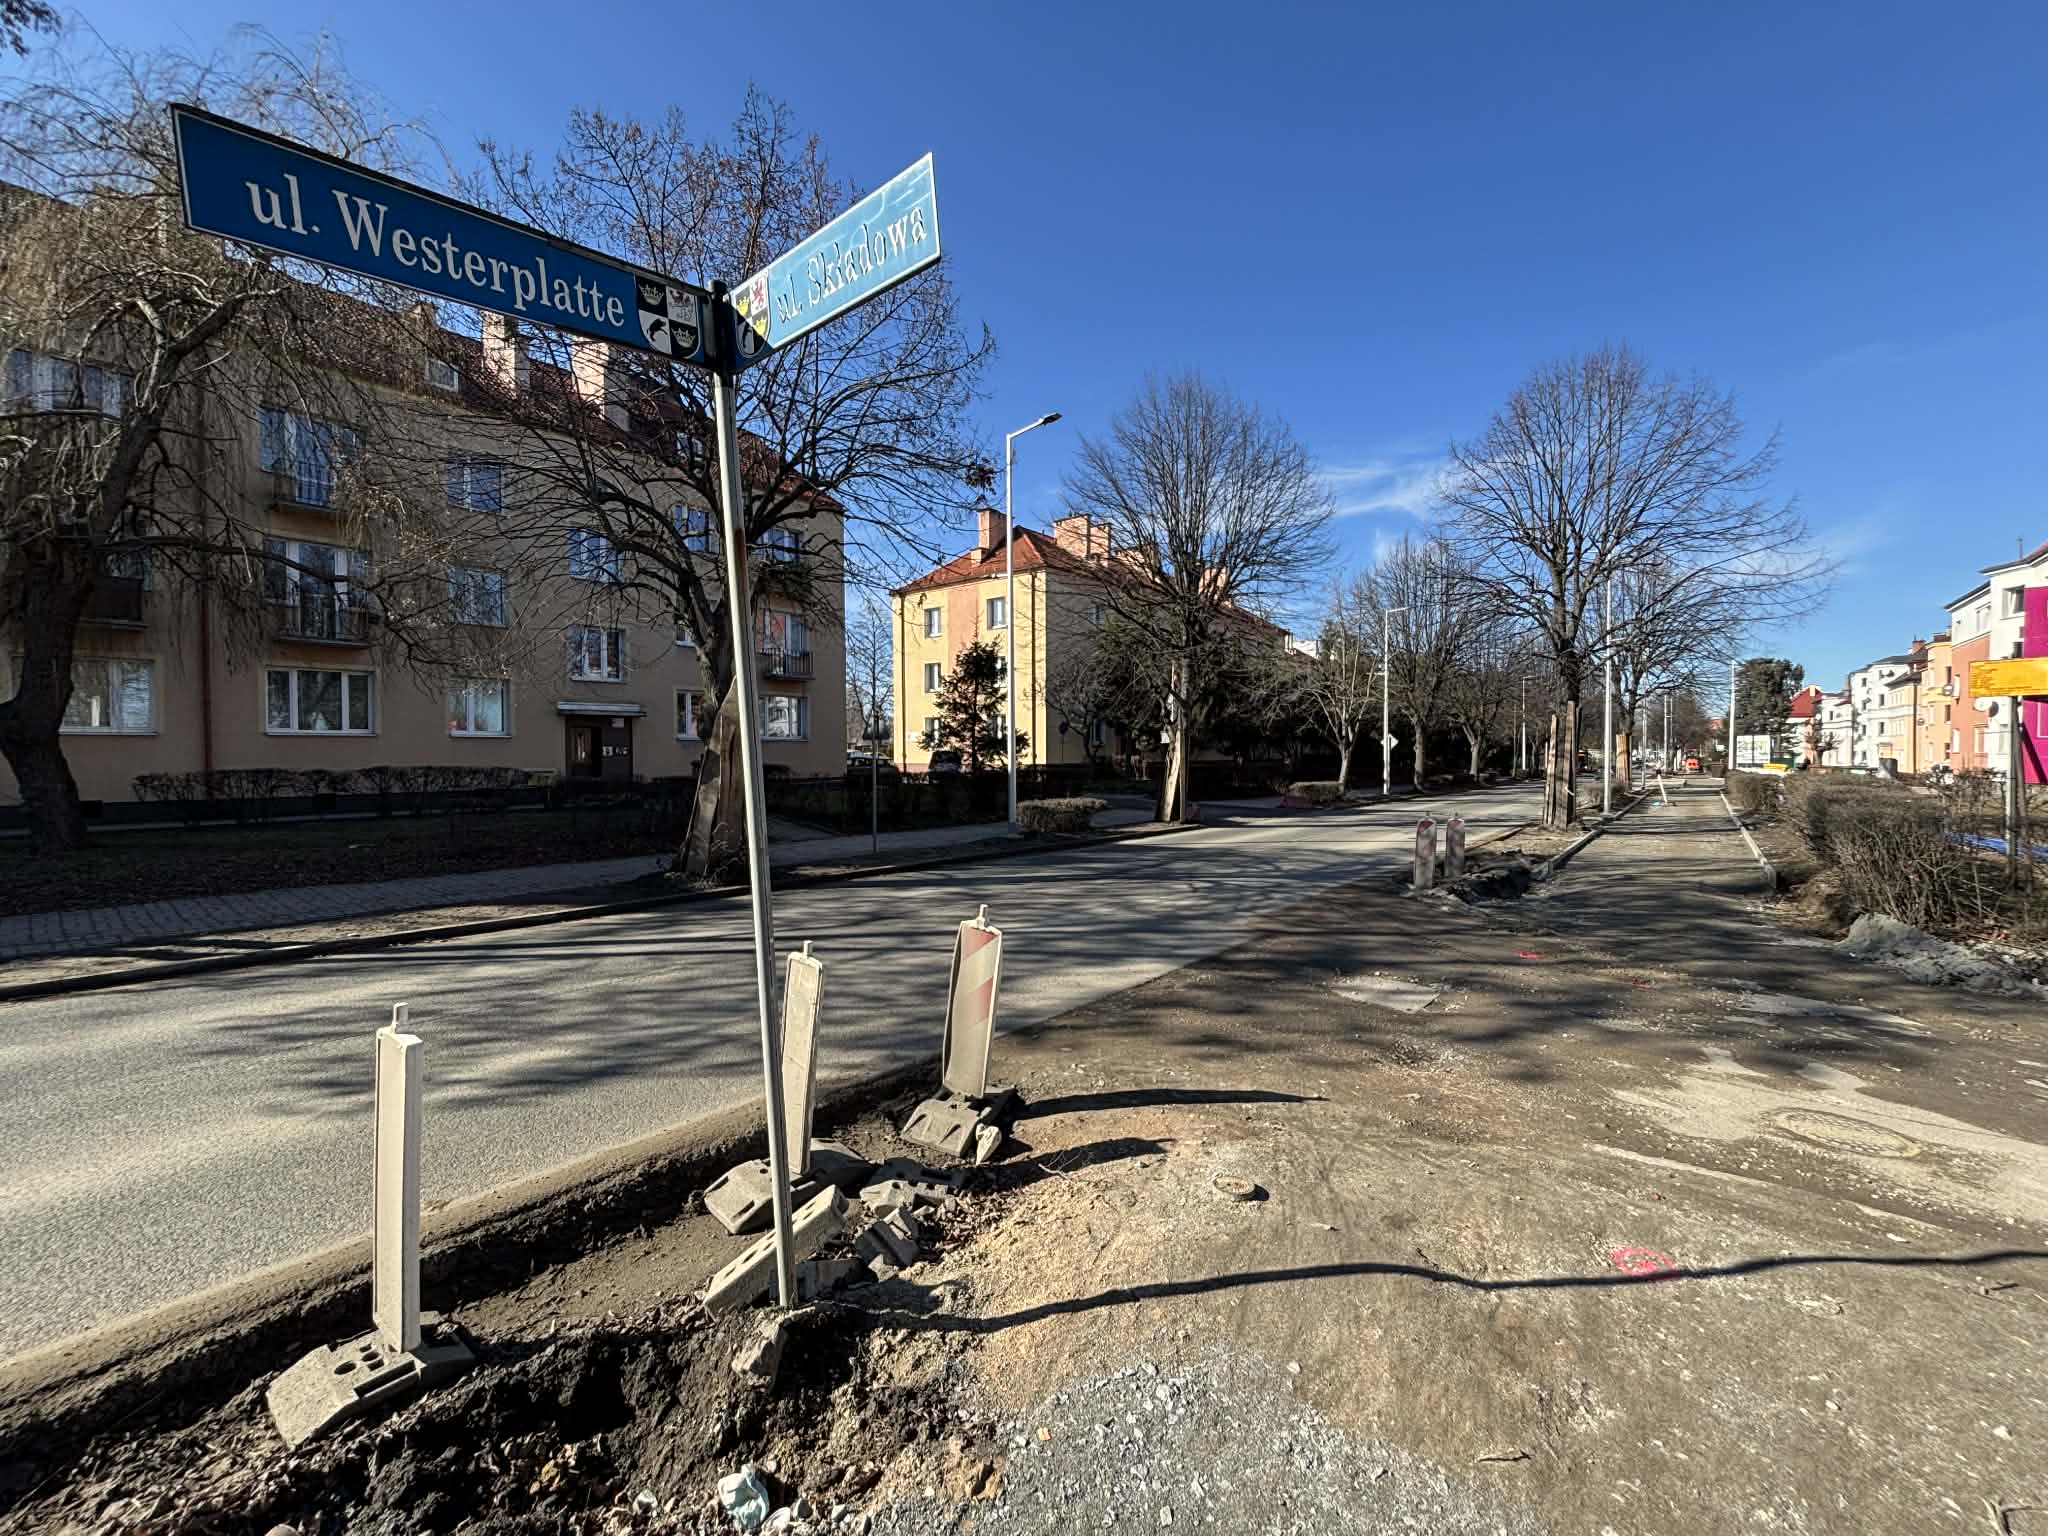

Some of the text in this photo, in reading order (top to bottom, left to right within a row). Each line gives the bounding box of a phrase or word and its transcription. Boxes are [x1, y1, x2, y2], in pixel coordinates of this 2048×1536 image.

[245, 172, 626, 328] ul. Westerplatte
[776, 275, 803, 325] ul.
